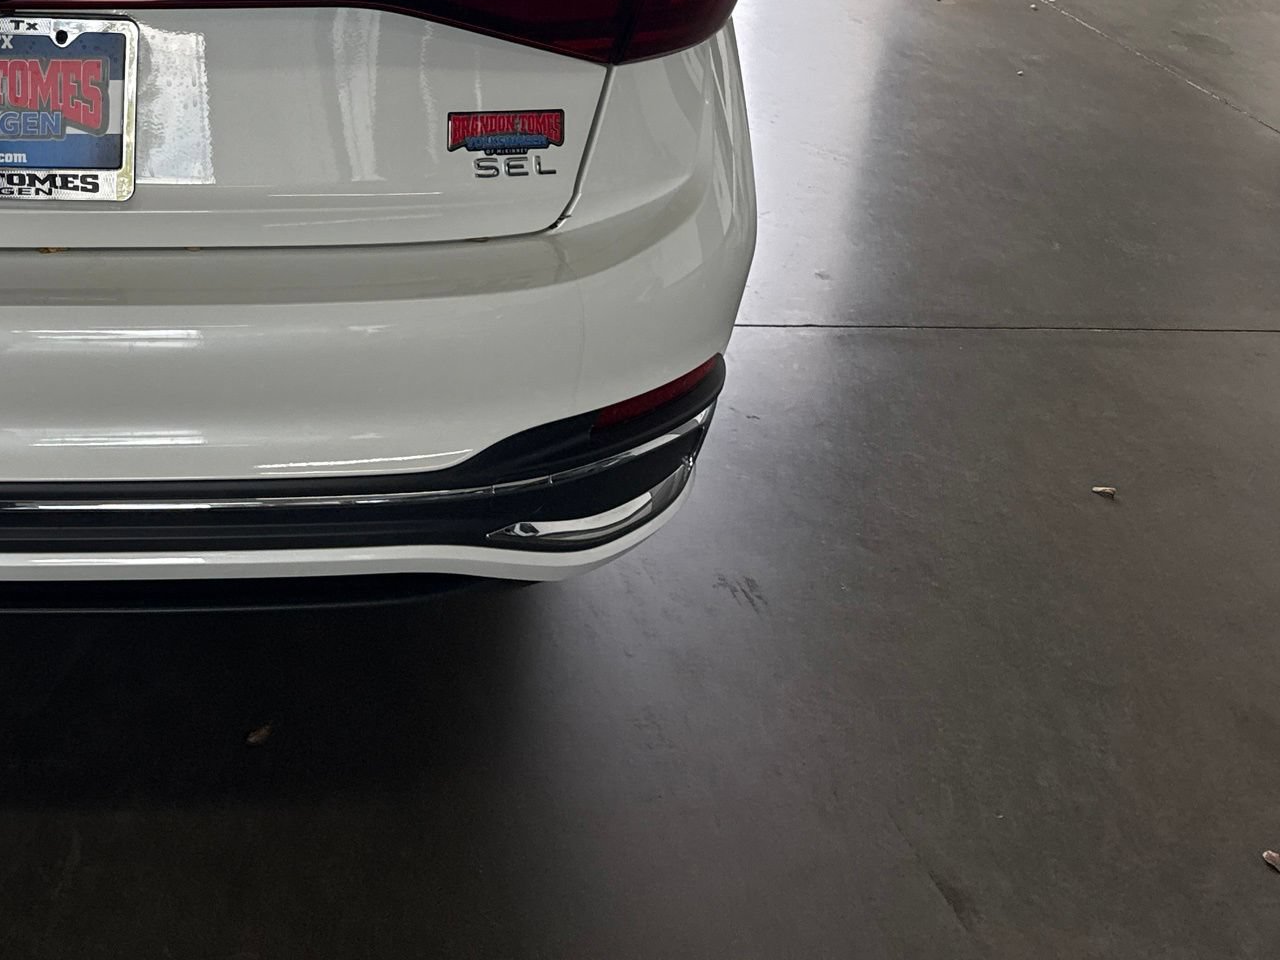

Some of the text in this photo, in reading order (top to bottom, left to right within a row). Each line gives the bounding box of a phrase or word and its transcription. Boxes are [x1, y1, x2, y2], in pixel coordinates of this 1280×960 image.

[10, 19, 39, 31] Tx
[451, 112, 561, 146] BRANDON TOMES
[472, 155, 557, 178] SEL
